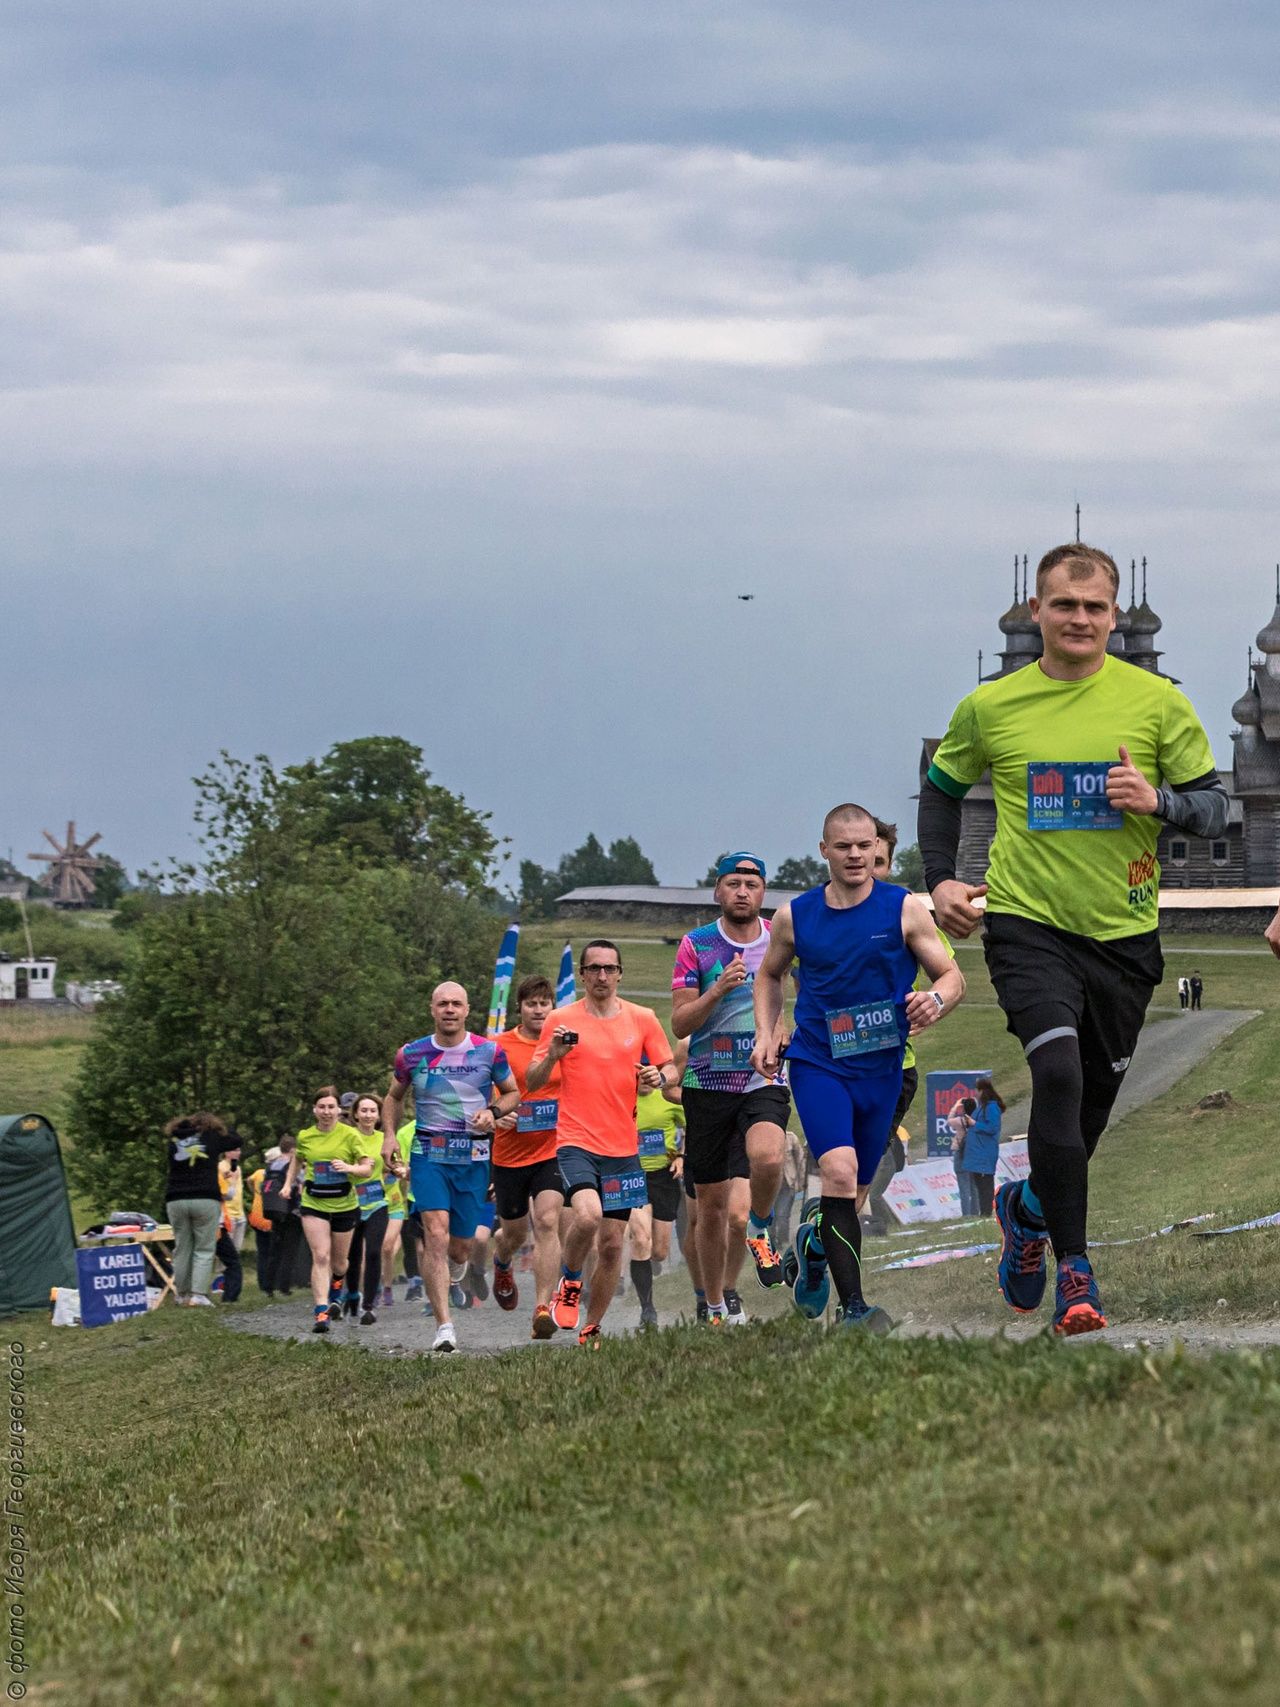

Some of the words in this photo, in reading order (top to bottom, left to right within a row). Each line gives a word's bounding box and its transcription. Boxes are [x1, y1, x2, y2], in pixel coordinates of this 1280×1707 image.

[1072, 773, 1109, 795] 101
[1033, 796, 1064, 808] RUN
[1129, 885, 1154, 904] RUN
[855, 1008, 894, 1029] 2108
[833, 1031, 857, 1044] RUN
[713, 1051, 733, 1059] RUN
[419, 1066, 479, 1074] CITYLINK
[535, 1105, 555, 1115] 2117
[448, 1138, 470, 1148] 2101
[621, 1176, 645, 1190] 2105
[604, 1192, 621, 1200] RUN
[93, 1275, 117, 1290] ECO
